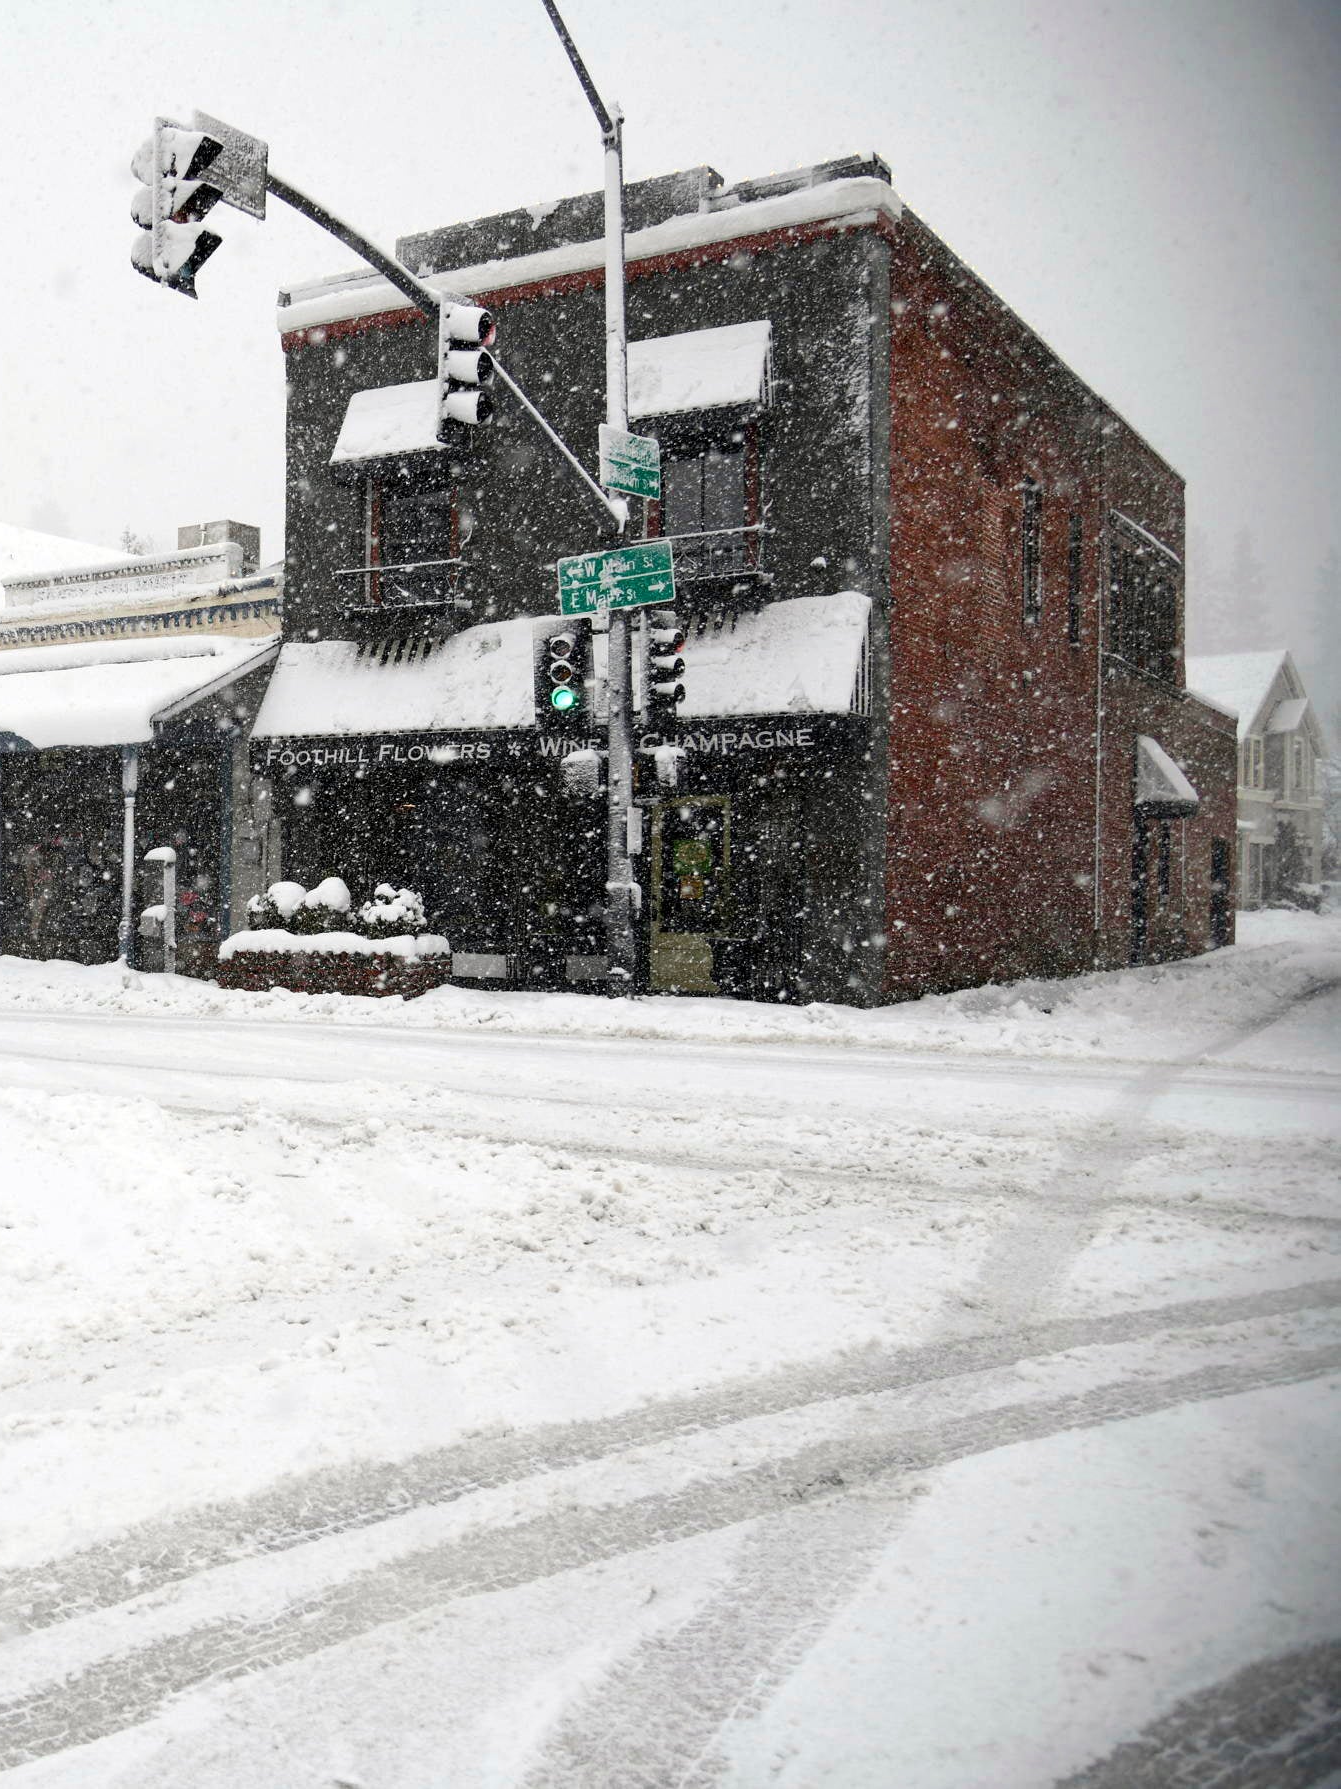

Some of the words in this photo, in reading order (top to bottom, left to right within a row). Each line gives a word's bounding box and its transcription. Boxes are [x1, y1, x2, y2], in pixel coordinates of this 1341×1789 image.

[584, 561, 596, 577] W
[643, 556, 654, 569] St
[571, 592, 580, 608] E
[626, 588, 637, 602] St
[266, 748, 370, 766] FOOTHILL
[378, 744, 491, 763] FLOWERS
[640, 728, 814, 754] CHAMPAGNE
